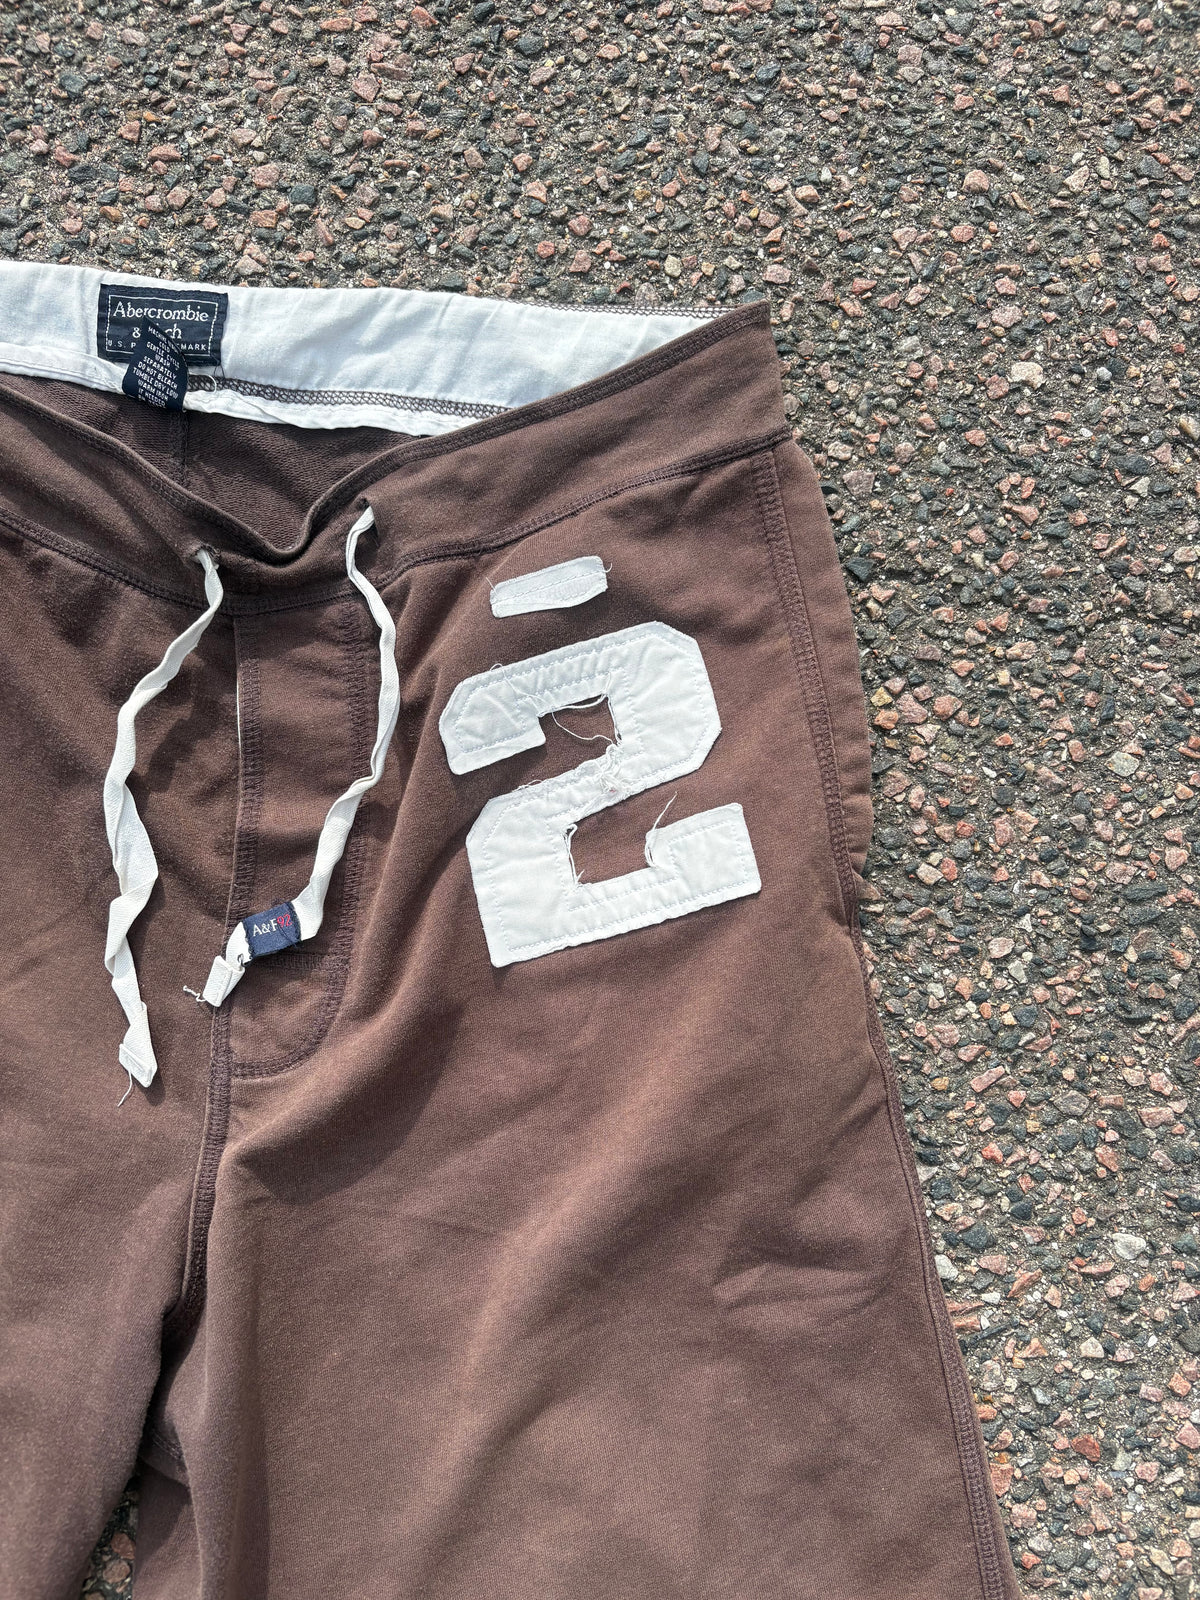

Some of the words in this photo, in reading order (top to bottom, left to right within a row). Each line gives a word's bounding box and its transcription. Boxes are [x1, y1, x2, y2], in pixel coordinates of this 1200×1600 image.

[113, 301, 209, 322] Abercrombie
[132, 327, 141, 338] &
[146, 341, 164, 357] GENTLE
[143, 356, 177, 380] SEPARATELY
[155, 353, 170, 367] WASH
[133, 366, 154, 384] TUMBLE
[154, 380, 166, 391] DRY
[138, 361, 146, 370] DO
[146, 366, 157, 377] NOT
[157, 373, 177, 390] BLEACH
[138, 379, 156, 394] WARM
[439, 621, 762, 967] 2
